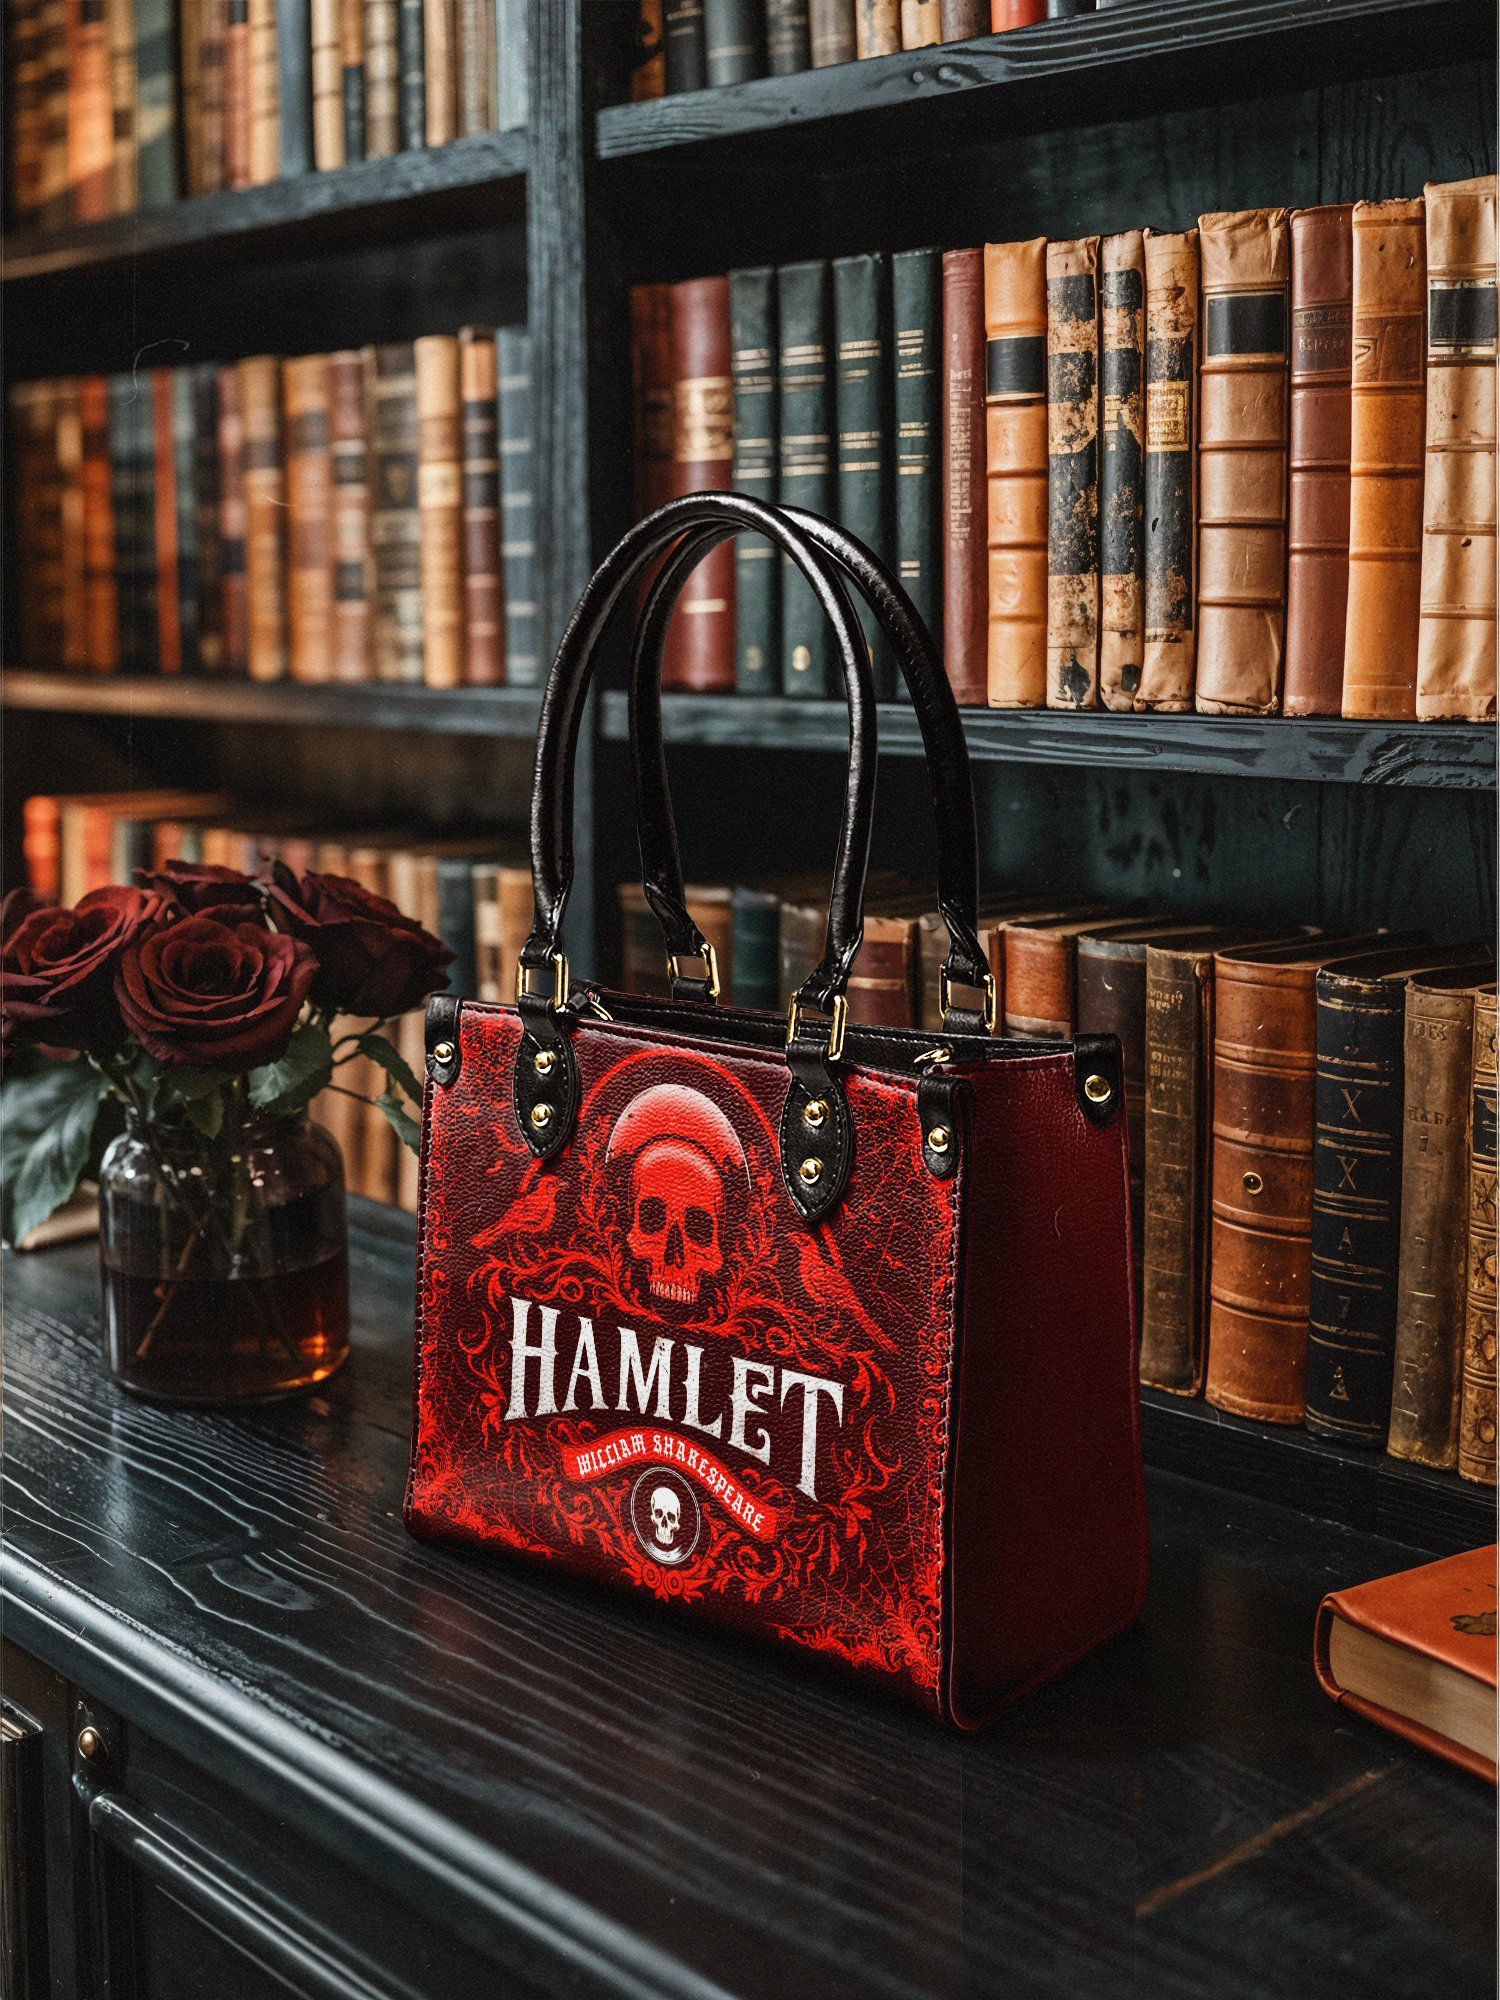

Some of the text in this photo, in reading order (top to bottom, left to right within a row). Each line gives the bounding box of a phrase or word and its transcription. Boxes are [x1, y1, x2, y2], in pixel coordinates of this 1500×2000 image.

[504, 1296, 847, 1502] HAMLET
[576, 1434, 766, 1532] WILLIAM SHAKESPEARE
